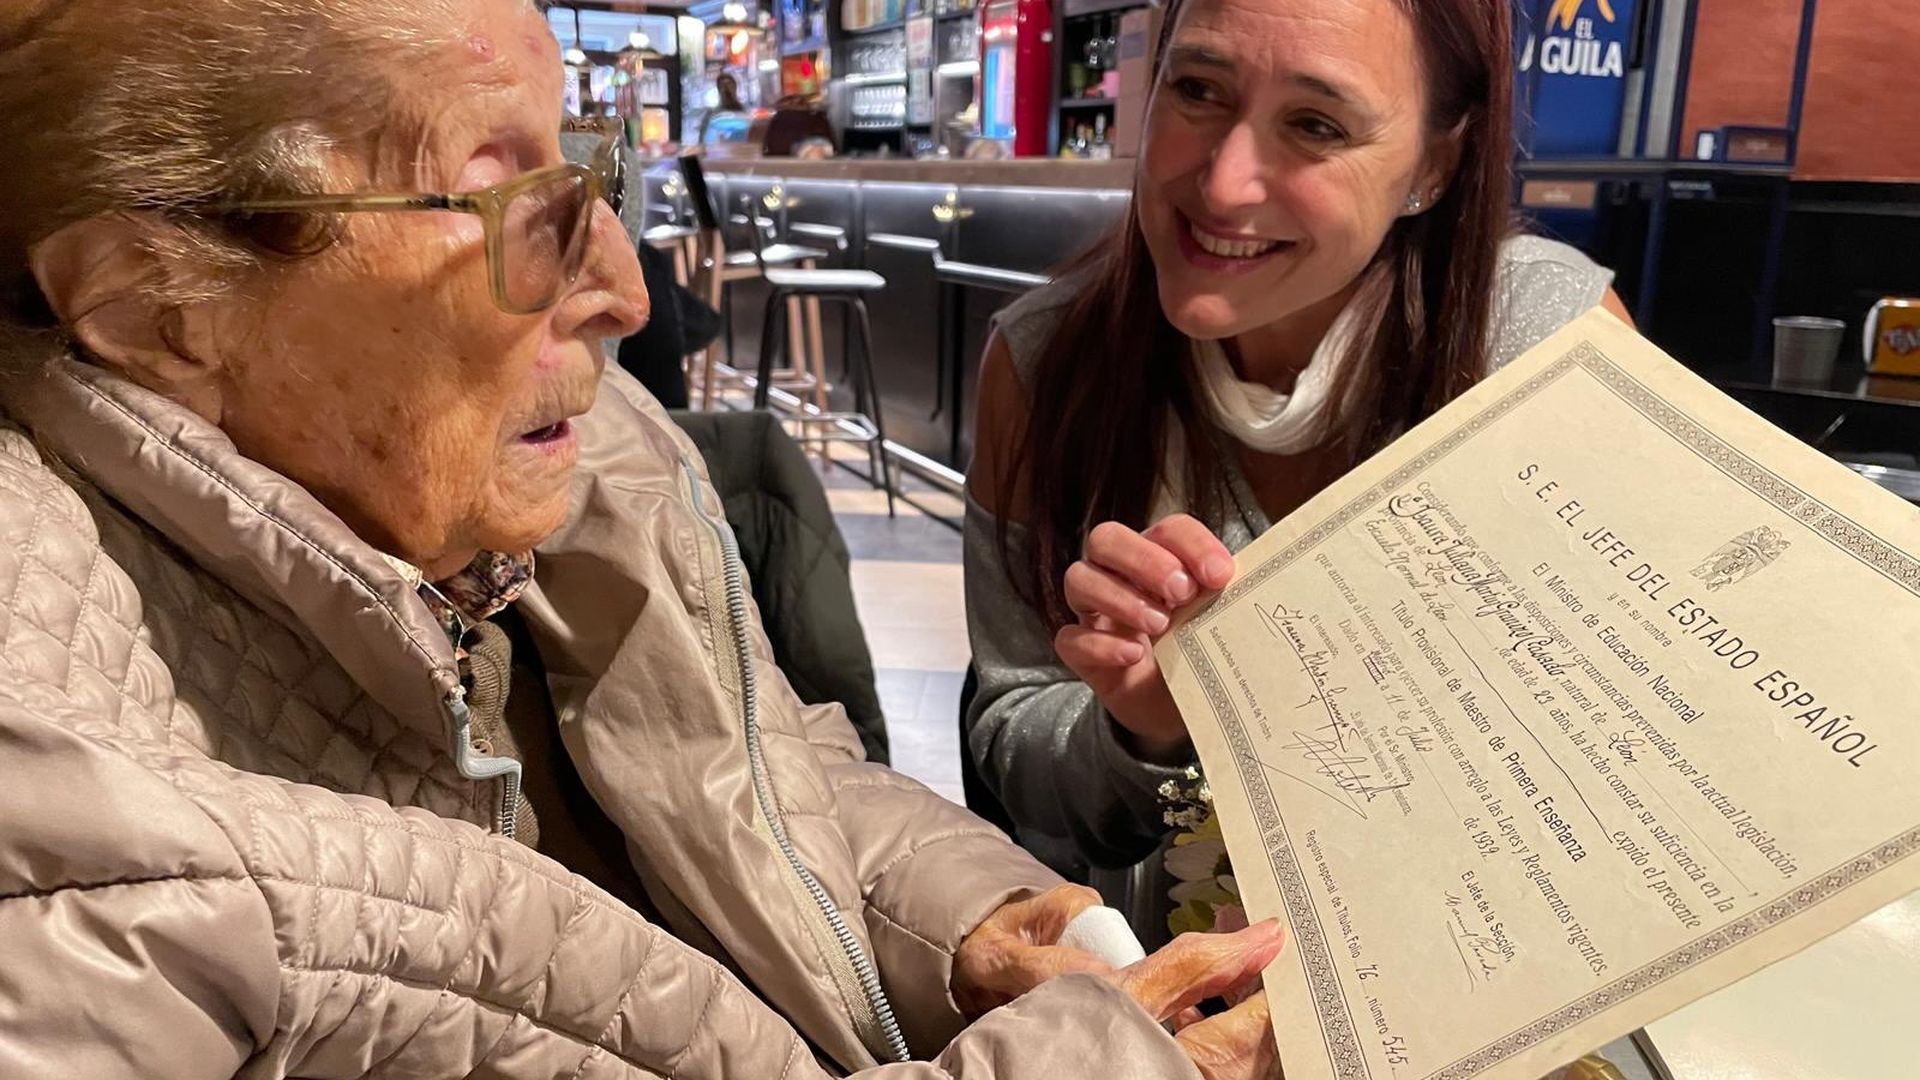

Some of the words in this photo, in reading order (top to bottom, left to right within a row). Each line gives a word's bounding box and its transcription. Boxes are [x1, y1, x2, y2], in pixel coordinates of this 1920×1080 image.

[1575, 17, 1594, 39] EL
[1377, 501, 1416, 546] provincia
[1365, 518, 1402, 555] Escuela
[1314, 553, 1333, 570] que
[1412, 545, 1430, 557] de
[1384, 551, 1429, 590] Normal
[1327, 569, 1358, 605] autoriza
[1309, 613, 1320, 625] El
[1352, 604, 1369, 614] al
[1517, 464, 1539, 486] S.
[1535, 481, 1559, 503] E.
[1556, 500, 1585, 528] EL
[1582, 527, 1635, 567] JEFE
[1626, 563, 1670, 601] DEL
[1668, 598, 1759, 669] ESTADO
[1754, 670, 1875, 767] ESPAÑOL
[1606, 592, 1620, 602] y
[1616, 598, 1631, 610] en
[1628, 609, 1643, 621] su
[1640, 620, 1673, 648] nombre
[1337, 618, 1359, 643] Dado
[1358, 611, 1393, 654] interesado
[1353, 643, 1366, 655] en
[1498, 647, 1517, 659] de
[1532, 562, 1552, 577] El
[1545, 575, 1584, 613] Ministro
[1581, 613, 1600, 629] de
[1596, 626, 1650, 677] Educación
[1647, 675, 1704, 724] Nacional
[1209, 625, 1236, 668] Satisfechos
[1232, 666, 1242, 680] los
[1238, 678, 1257, 709] derechos
[1253, 707, 1262, 719] de
[1384, 651, 1405, 674] para
[1507, 658, 1533, 679] edad
[1379, 683, 1391, 692] a
[1398, 670, 1423, 697] ejercer
[1417, 481, 1467, 537] Considerando
[1476, 551, 1512, 586] conforme
[1506, 585, 1518, 593] a
[1512, 587, 1529, 604] las
[1523, 601, 1572, 649] disposiciones
[1561, 646, 1579, 655] y
[1572, 653, 1633, 712] circunstancias
[1622, 709, 1680, 761] prevenidas
[1668, 758, 1698, 777] por
[1690, 774, 1710, 789] la
[1701, 787, 1746, 819] actual
[1732, 815, 1797, 879] legislación,
[1523, 676, 1539, 689] de
[1416, 696, 1430, 708] su
[1559, 679, 1599, 712] natural
[1590, 712, 1607, 726] de
[1396, 710, 1412, 723] de
[1419, 706, 1455, 744] profesión
[1549, 708, 1574, 735] años,
[1377, 725, 1390, 739] Por
[1391, 599, 1414, 630] Título
[1411, 627, 1455, 678] Provisional
[1446, 678, 1462, 693] de
[1457, 691, 1492, 734] Maestro
[1488, 736, 1506, 752] de
[1501, 751, 1538, 798] Primera
[1534, 796, 1586, 862] Enseñanza
[1395, 725, 1434, 752] Julio
[1569, 730, 1587, 747] ha
[1384, 738, 1396, 747] el
[1388, 743, 1400, 755] Sr.
[1447, 743, 1465, 761] con
[1580, 743, 1611, 775] hecho
[1458, 759, 1489, 794] arreglo
[1480, 793, 1493, 802] a
[1606, 774, 1644, 810] constar
[1485, 799, 1504, 818] las
[1637, 811, 1656, 826] su
[1463, 817, 1480, 831] de
[1496, 815, 1524, 848] Leyes
[1511, 845, 1530, 855] y
[1608, 830, 1650, 866] expido
[1649, 825, 1707, 882] suficiencia
[1461, 870, 1475, 882] El
[1642, 867, 1666, 880] el
[1466, 881, 1484, 901] Jefe
[1521, 853, 1574, 924] Reglamentos
[1699, 881, 1721, 899] en
[1476, 900, 1489, 913] de
[1647, 880, 1701, 929] presente
[1713, 896, 1735, 913] la
[1484, 910, 1495, 923] la
[1305, 829, 1323, 862] Registro
[1317, 861, 1339, 895] especial
[1331, 896, 1342, 908] de
[1346, 935, 1362, 959] Folio
[1368, 998, 1389, 1035] número
[1489, 922, 1515, 963] Sección,
[1567, 923, 1608, 977] vigentes.
